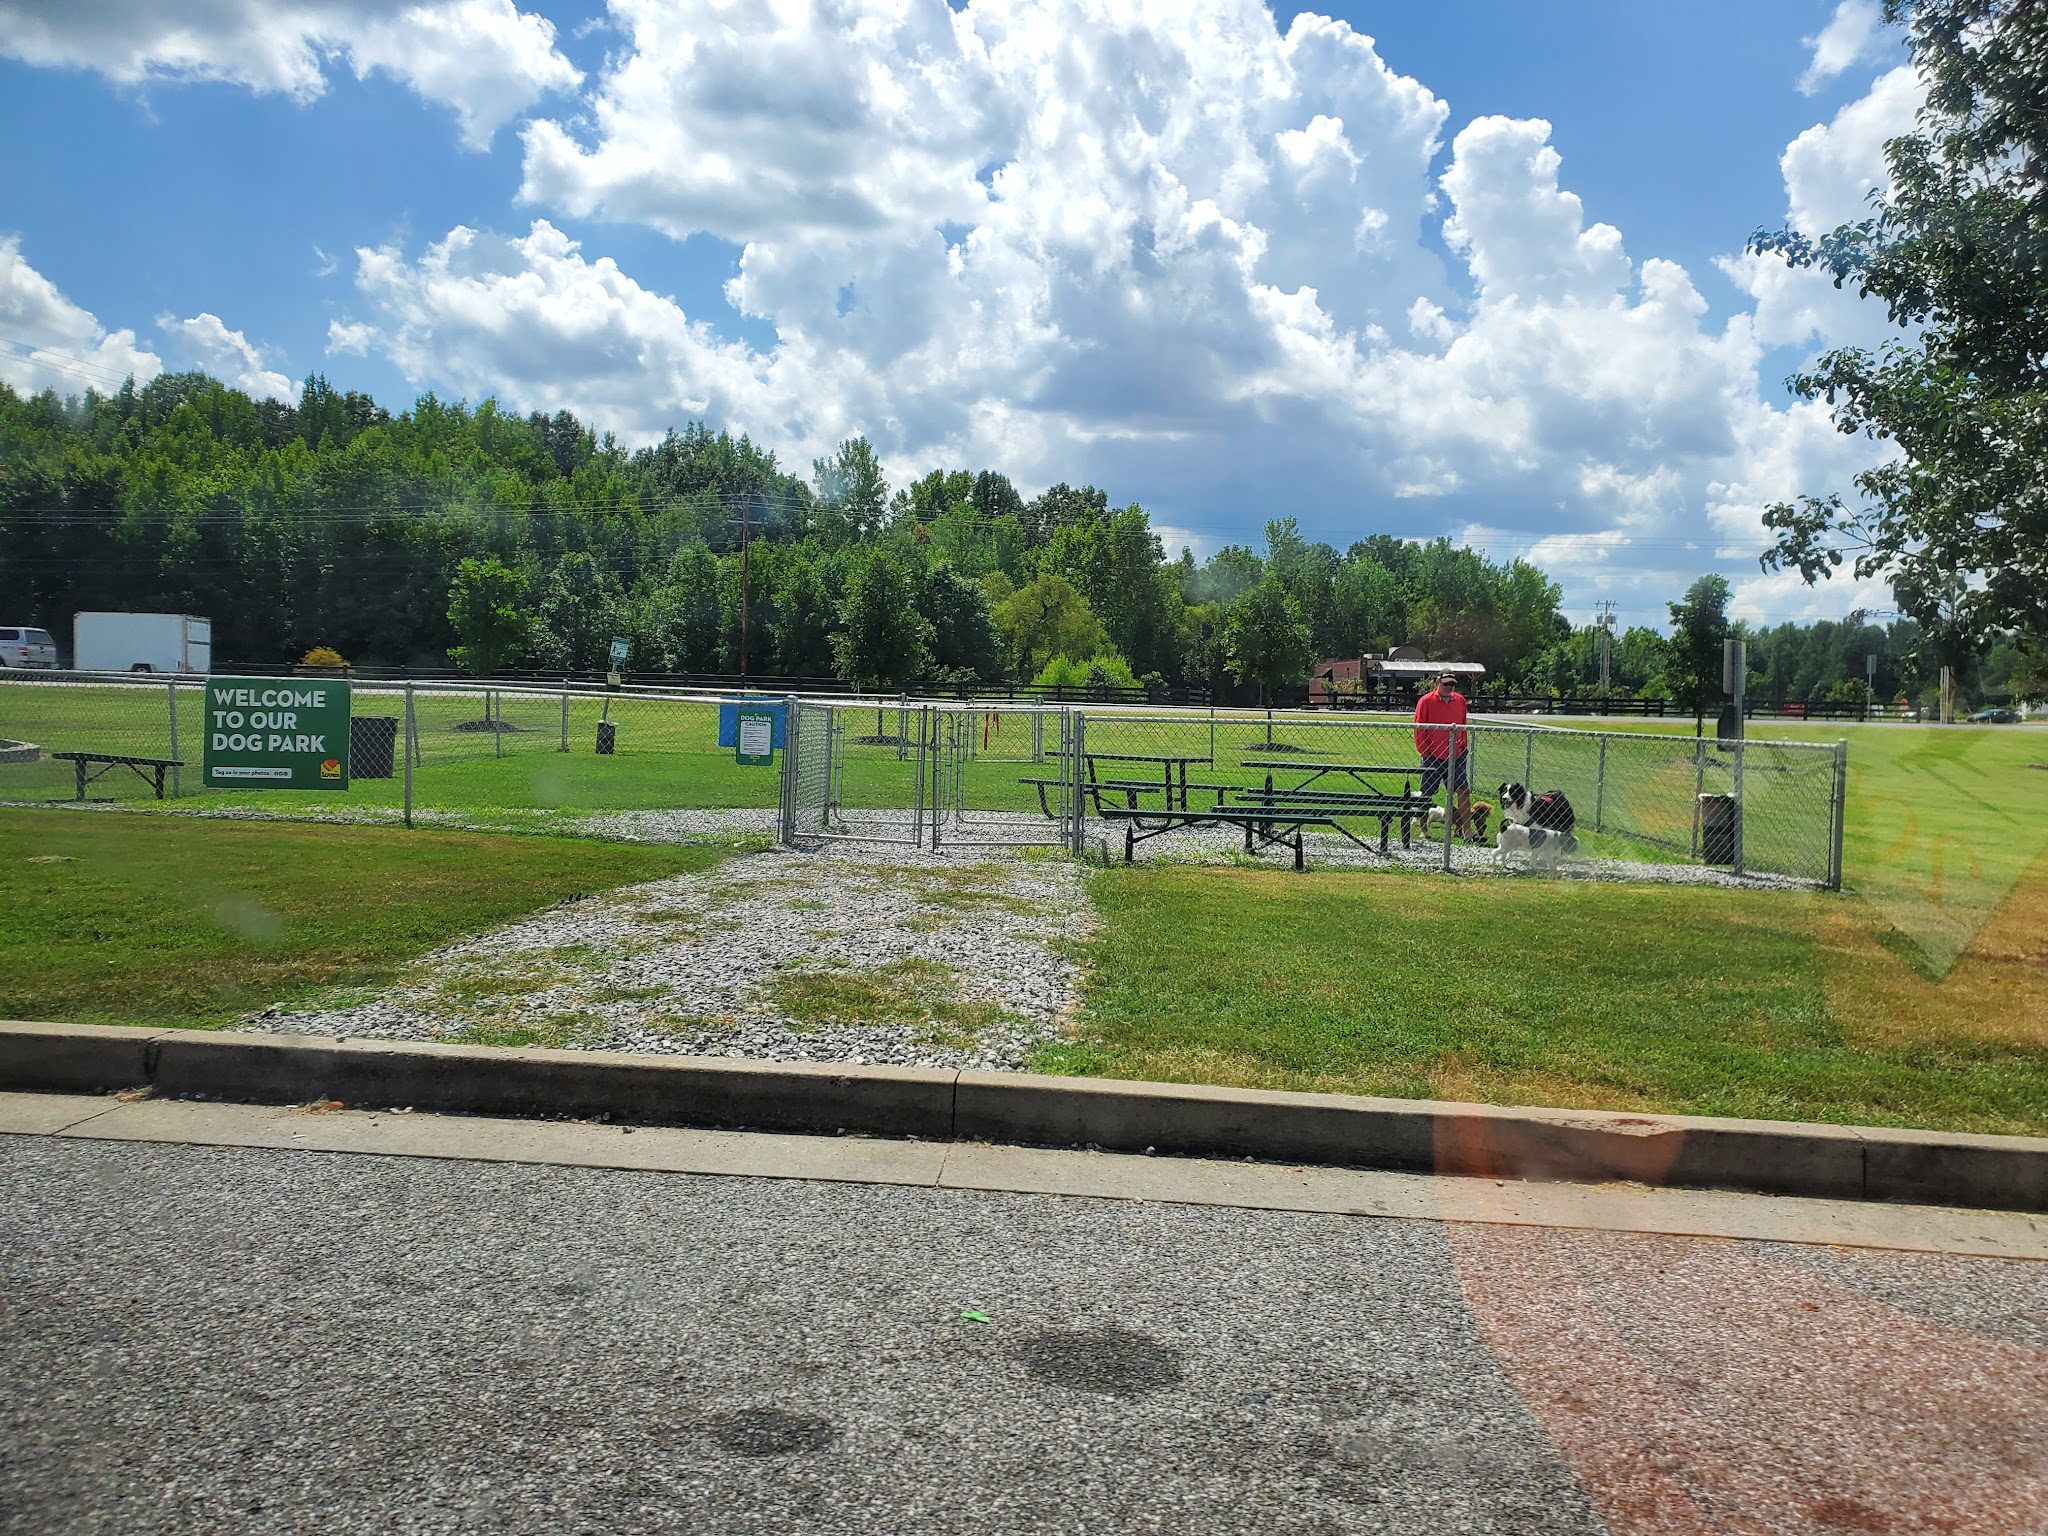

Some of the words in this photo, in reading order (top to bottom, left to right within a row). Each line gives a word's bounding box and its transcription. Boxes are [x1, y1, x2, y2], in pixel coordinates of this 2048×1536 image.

[213, 689, 326, 708] WELCOME
[213, 711, 244, 729] TO
[250, 712, 297, 729] OUR
[213, 733, 262, 752] DOG
[268, 735, 326, 753] PARK
